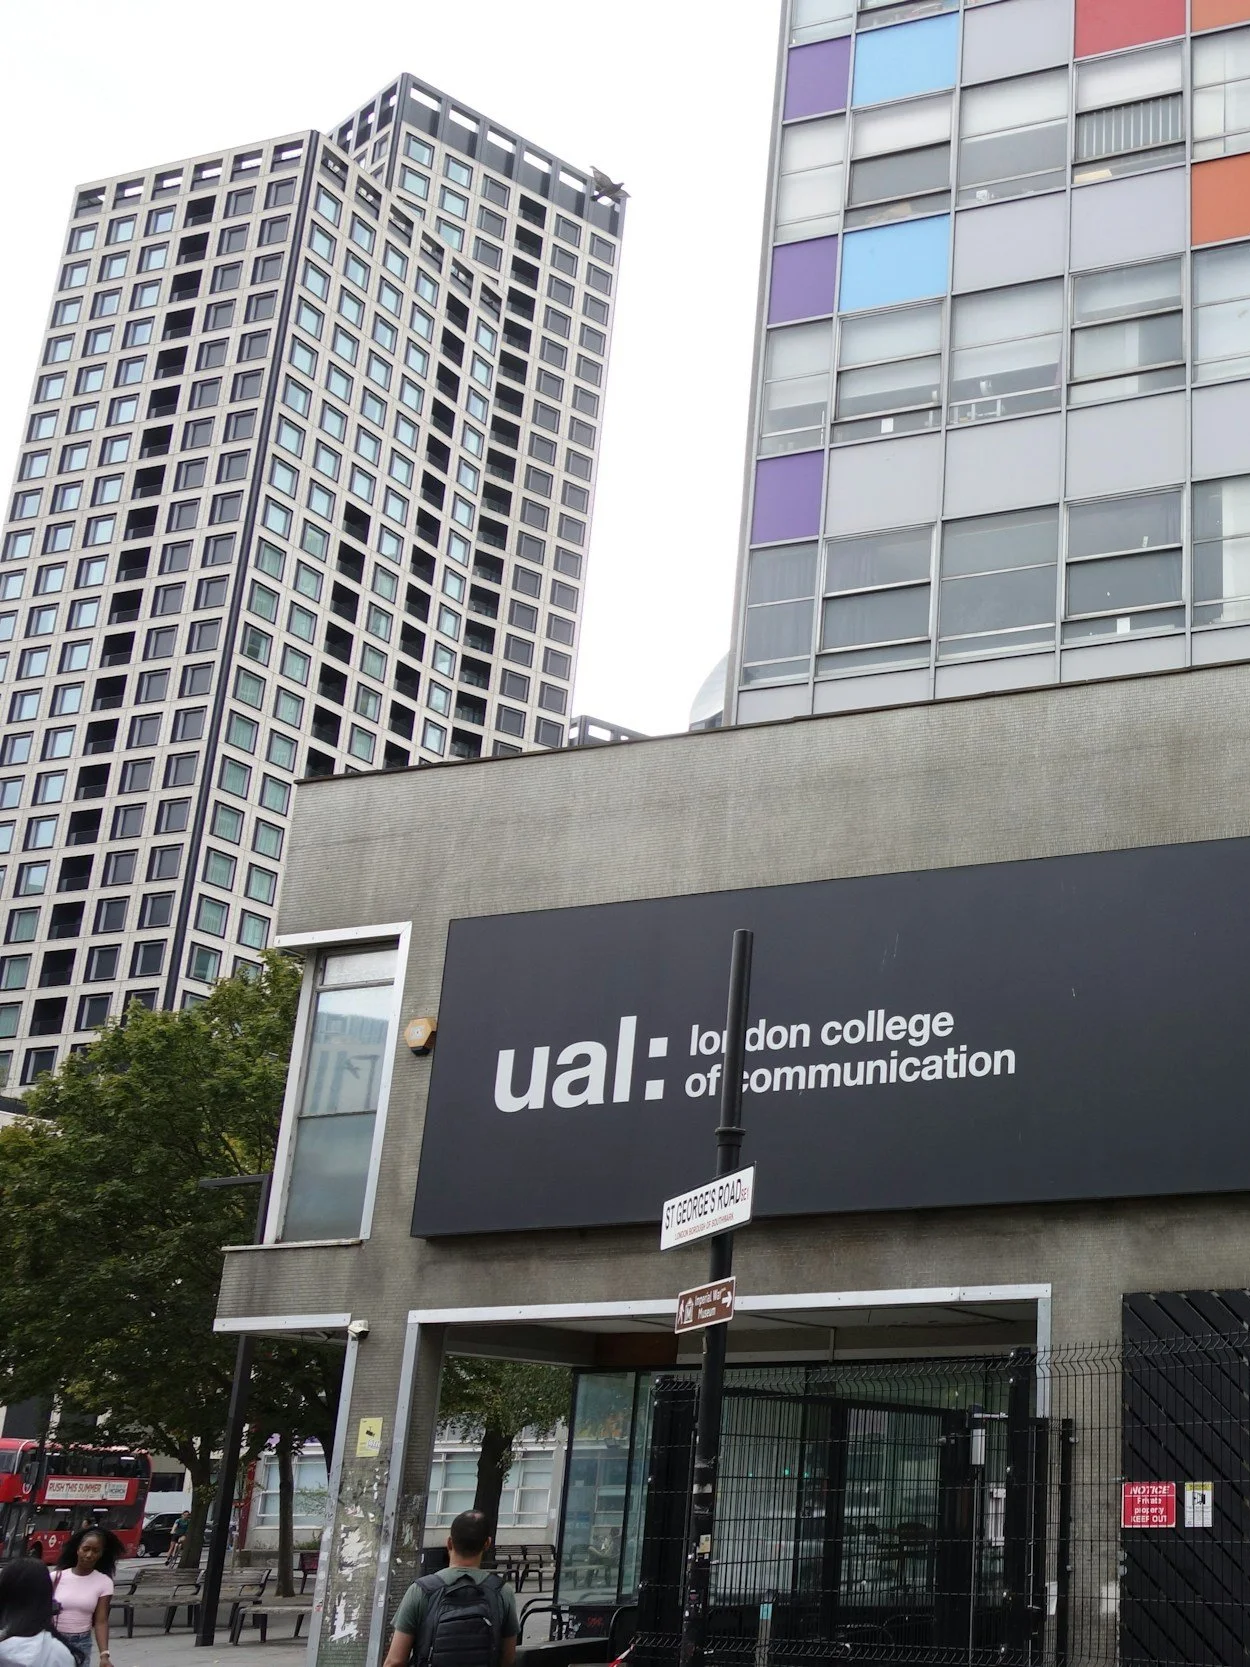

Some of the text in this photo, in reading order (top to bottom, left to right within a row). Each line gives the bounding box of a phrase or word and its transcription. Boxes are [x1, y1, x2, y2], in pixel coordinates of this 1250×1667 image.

[690, 1009, 954, 1056] lodon college
[494, 1015, 668, 1113] ual:
[685, 1064, 722, 1098] of
[665, 1179, 749, 1230] ST GEORGE'S ROAD SE1
[674, 1213, 734, 1241] LONDON BOROUGH OF SOUTHWARK
[694, 1289, 722, 1307] Imperial War
[698, 1307, 716, 1319] Museum
[1130, 1485, 1170, 1495] NOTICE
[1130, 1515, 1167, 1523] KEEP OUT
[1134, 1507, 1165, 1515] propery
